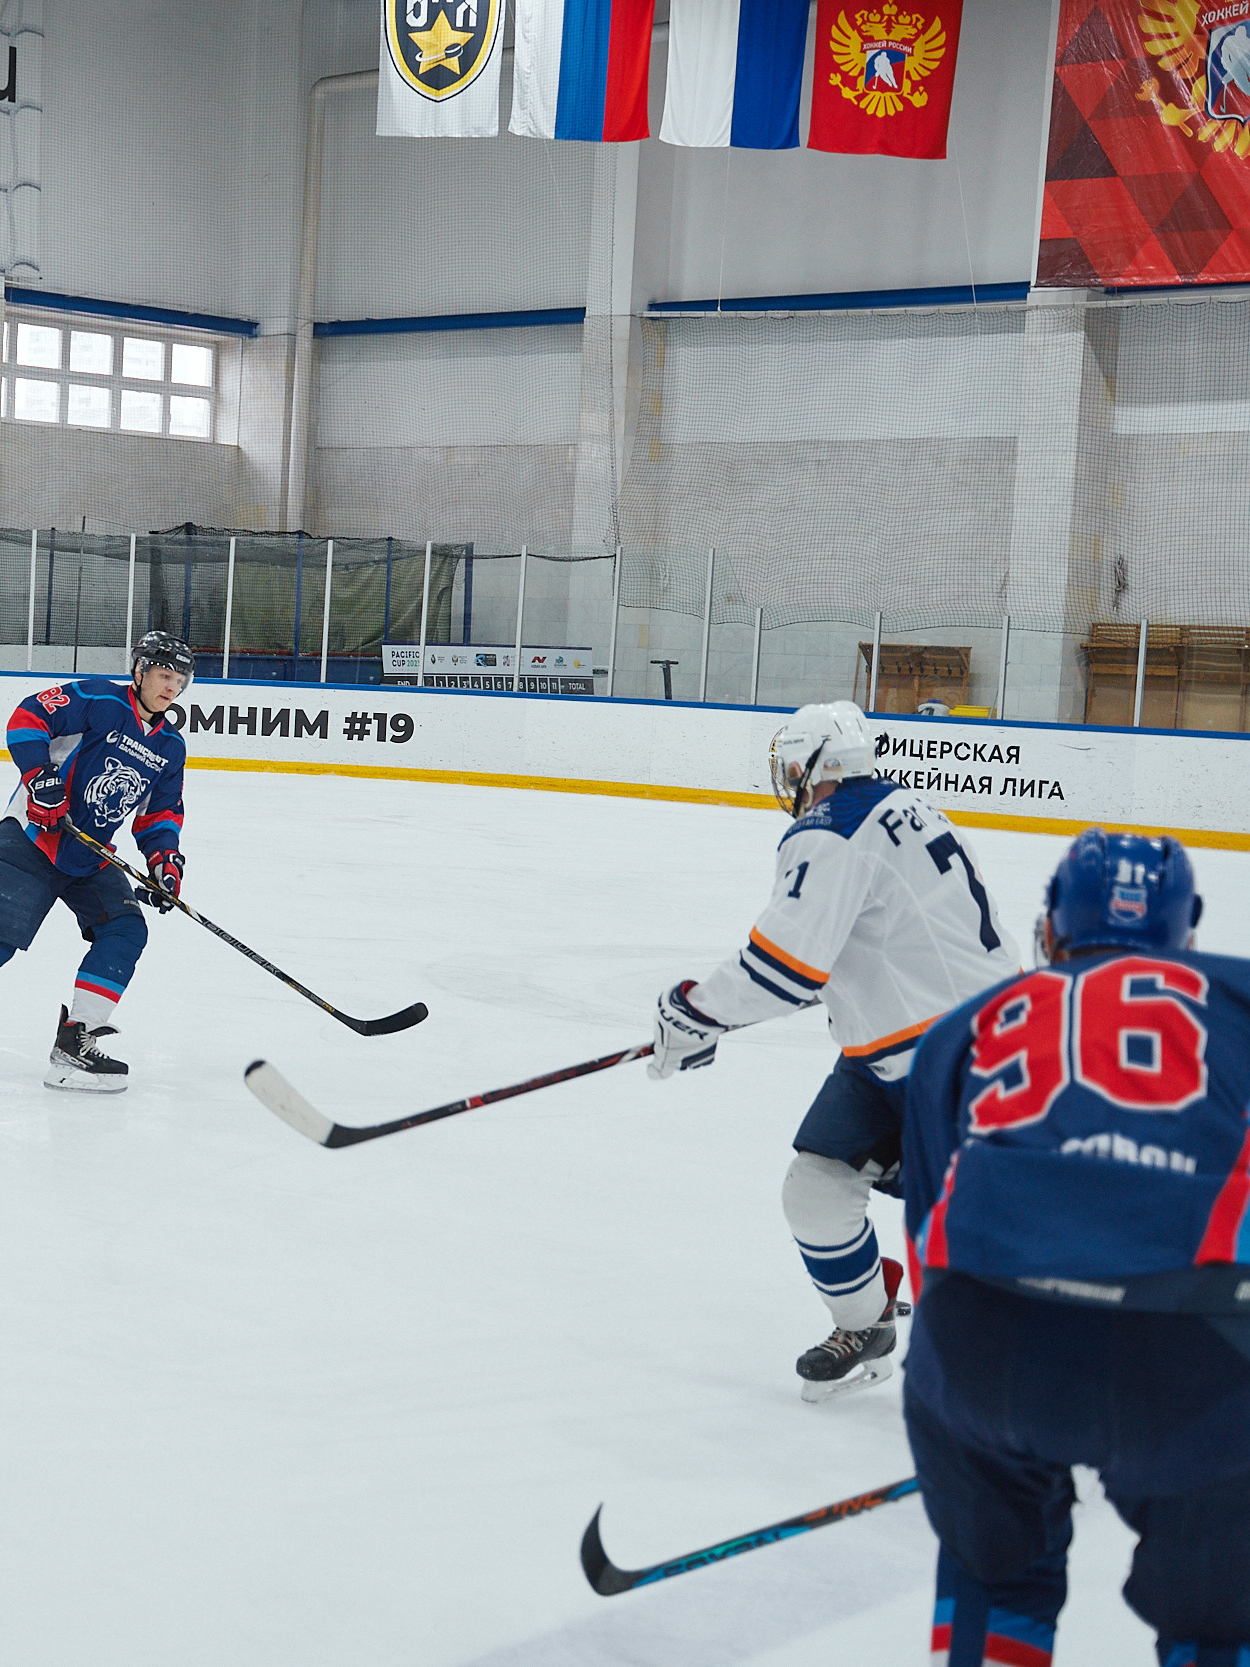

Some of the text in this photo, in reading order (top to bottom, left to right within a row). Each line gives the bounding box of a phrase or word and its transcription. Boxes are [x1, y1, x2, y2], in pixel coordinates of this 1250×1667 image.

[1201, 0, 1250, 27] ХОККЕЙ
[862, 40, 913, 54] ХОККЕЙ РОССИИ
[391, 650, 420, 659] PACIFIC
[391, 659, 406, 667] CUP
[36, 686, 71, 715] 82
[539, 682, 547, 690] 10
[551, 682, 557, 690] 11
[568, 682, 586, 691] TOTAL
[164, 702, 415, 744] ОМНИМ #19
[875, 735, 1021, 765] ФИЦЕРСКАЯ
[875, 767, 1065, 800] ККЕЙНАЯ ЛИГА
[968, 954, 1209, 1135] 96
